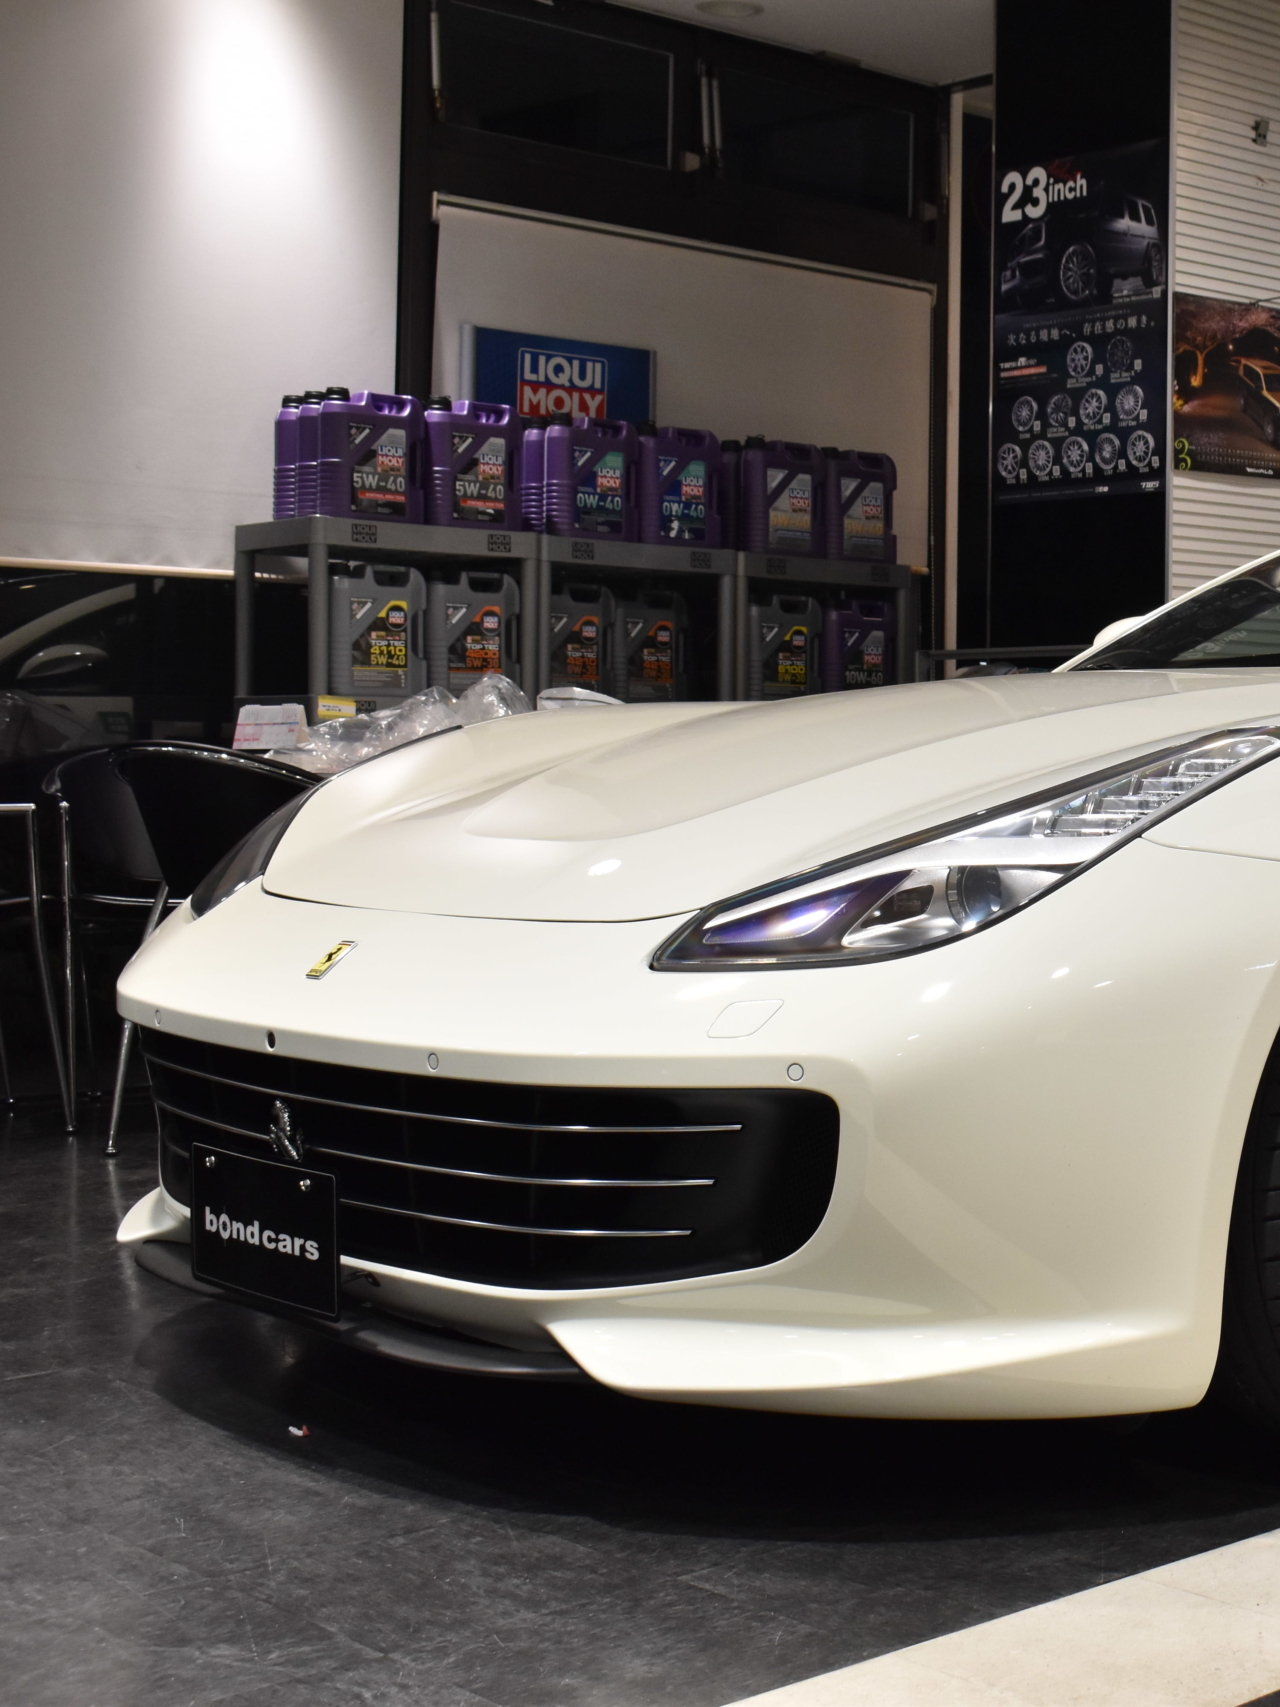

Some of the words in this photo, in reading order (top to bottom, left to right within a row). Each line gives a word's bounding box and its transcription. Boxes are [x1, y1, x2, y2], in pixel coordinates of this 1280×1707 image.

[1001, 166, 1047, 224] 23
[1048, 173, 1087, 203] inch
[524, 353, 602, 389] LIQUI
[523, 385, 603, 419] MOLY
[378, 445, 404, 457] LIQUI
[1174, 437, 1191, 471] 3
[378, 456, 404, 467] MOLY
[480, 453, 504, 465] LIQUI
[480, 464, 504, 475] MOLY
[599, 468, 622, 479] LIQUI
[353, 473, 405, 493] 5W-40
[598, 477, 622, 488] MOLY
[682, 476, 704, 486] LIQUI
[455, 481, 504, 500] 5W-40
[682, 485, 704, 496] MOLY
[577, 493, 622, 511] 0W-40
[662, 502, 705, 519] 0W-40
[352, 533, 377, 543] MOLY
[370, 647, 406, 656] 4110
[466, 650, 500, 659] 4200
[370, 655, 406, 666] 5W-40
[466, 659, 500, 669] 5W-30
[845, 671, 883, 684] 10W-60
[204, 1206, 320, 1261] bondcars
